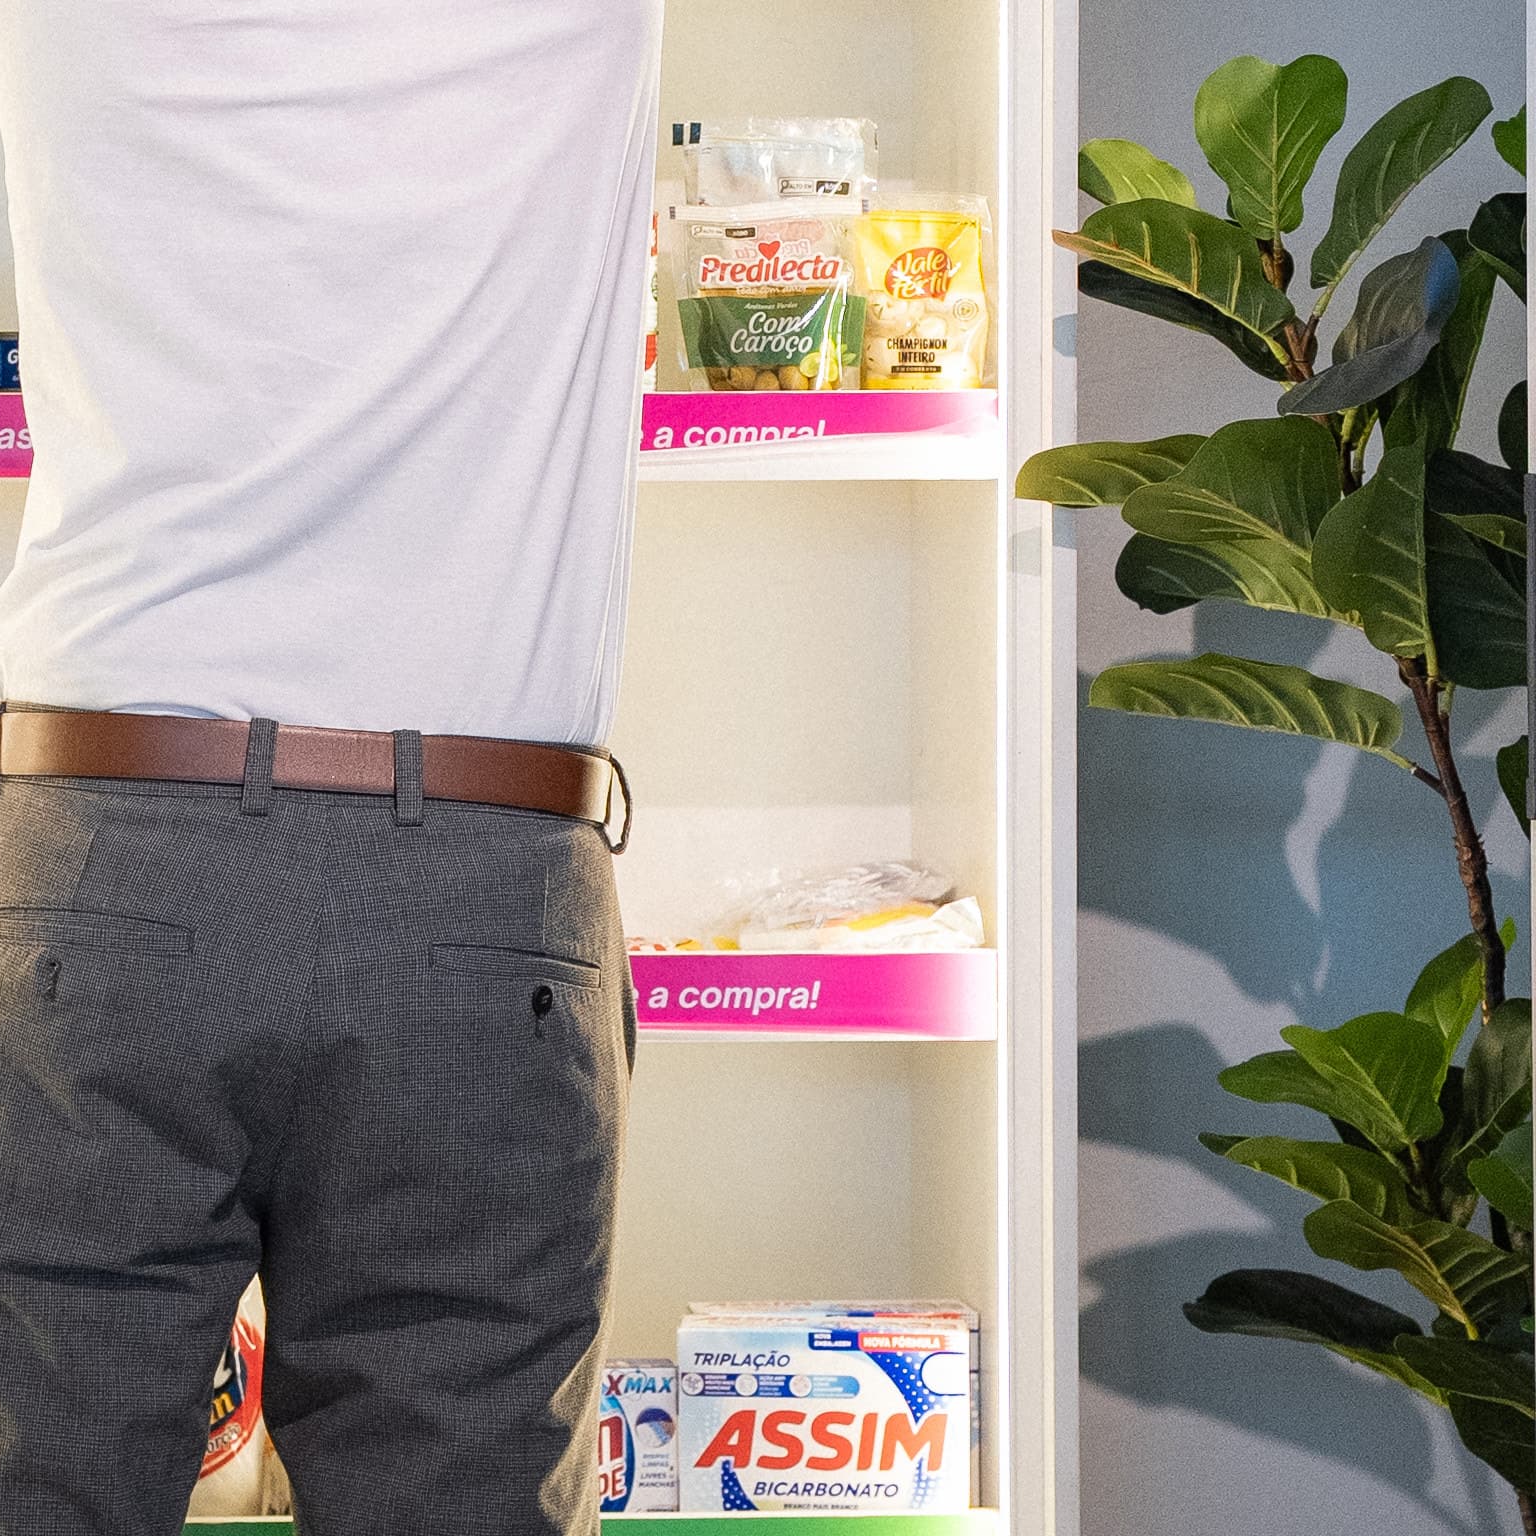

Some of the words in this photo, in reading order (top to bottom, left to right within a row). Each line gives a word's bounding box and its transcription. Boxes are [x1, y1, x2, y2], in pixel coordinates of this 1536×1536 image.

[700, 254, 841, 284] Predilecta
[896, 249, 946, 275] Vale
[748, 311, 807, 334] Com
[730, 328, 813, 359] Caroço
[886, 338, 948, 350] CHAMPIGNON
[897, 351, 936, 363] INTEIRO
[653, 426, 674, 449] a
[648, 985, 669, 1009] a
[678, 980, 822, 1016] compra!
[862, 1335, 892, 1349] NOVA
[893, 1334, 942, 1350] FÓRMULA
[693, 1350, 791, 1371] TRIPLAÇÃO
[693, 1409, 949, 1472] ASSIM
[753, 1481, 899, 1498] BICARBONATO
